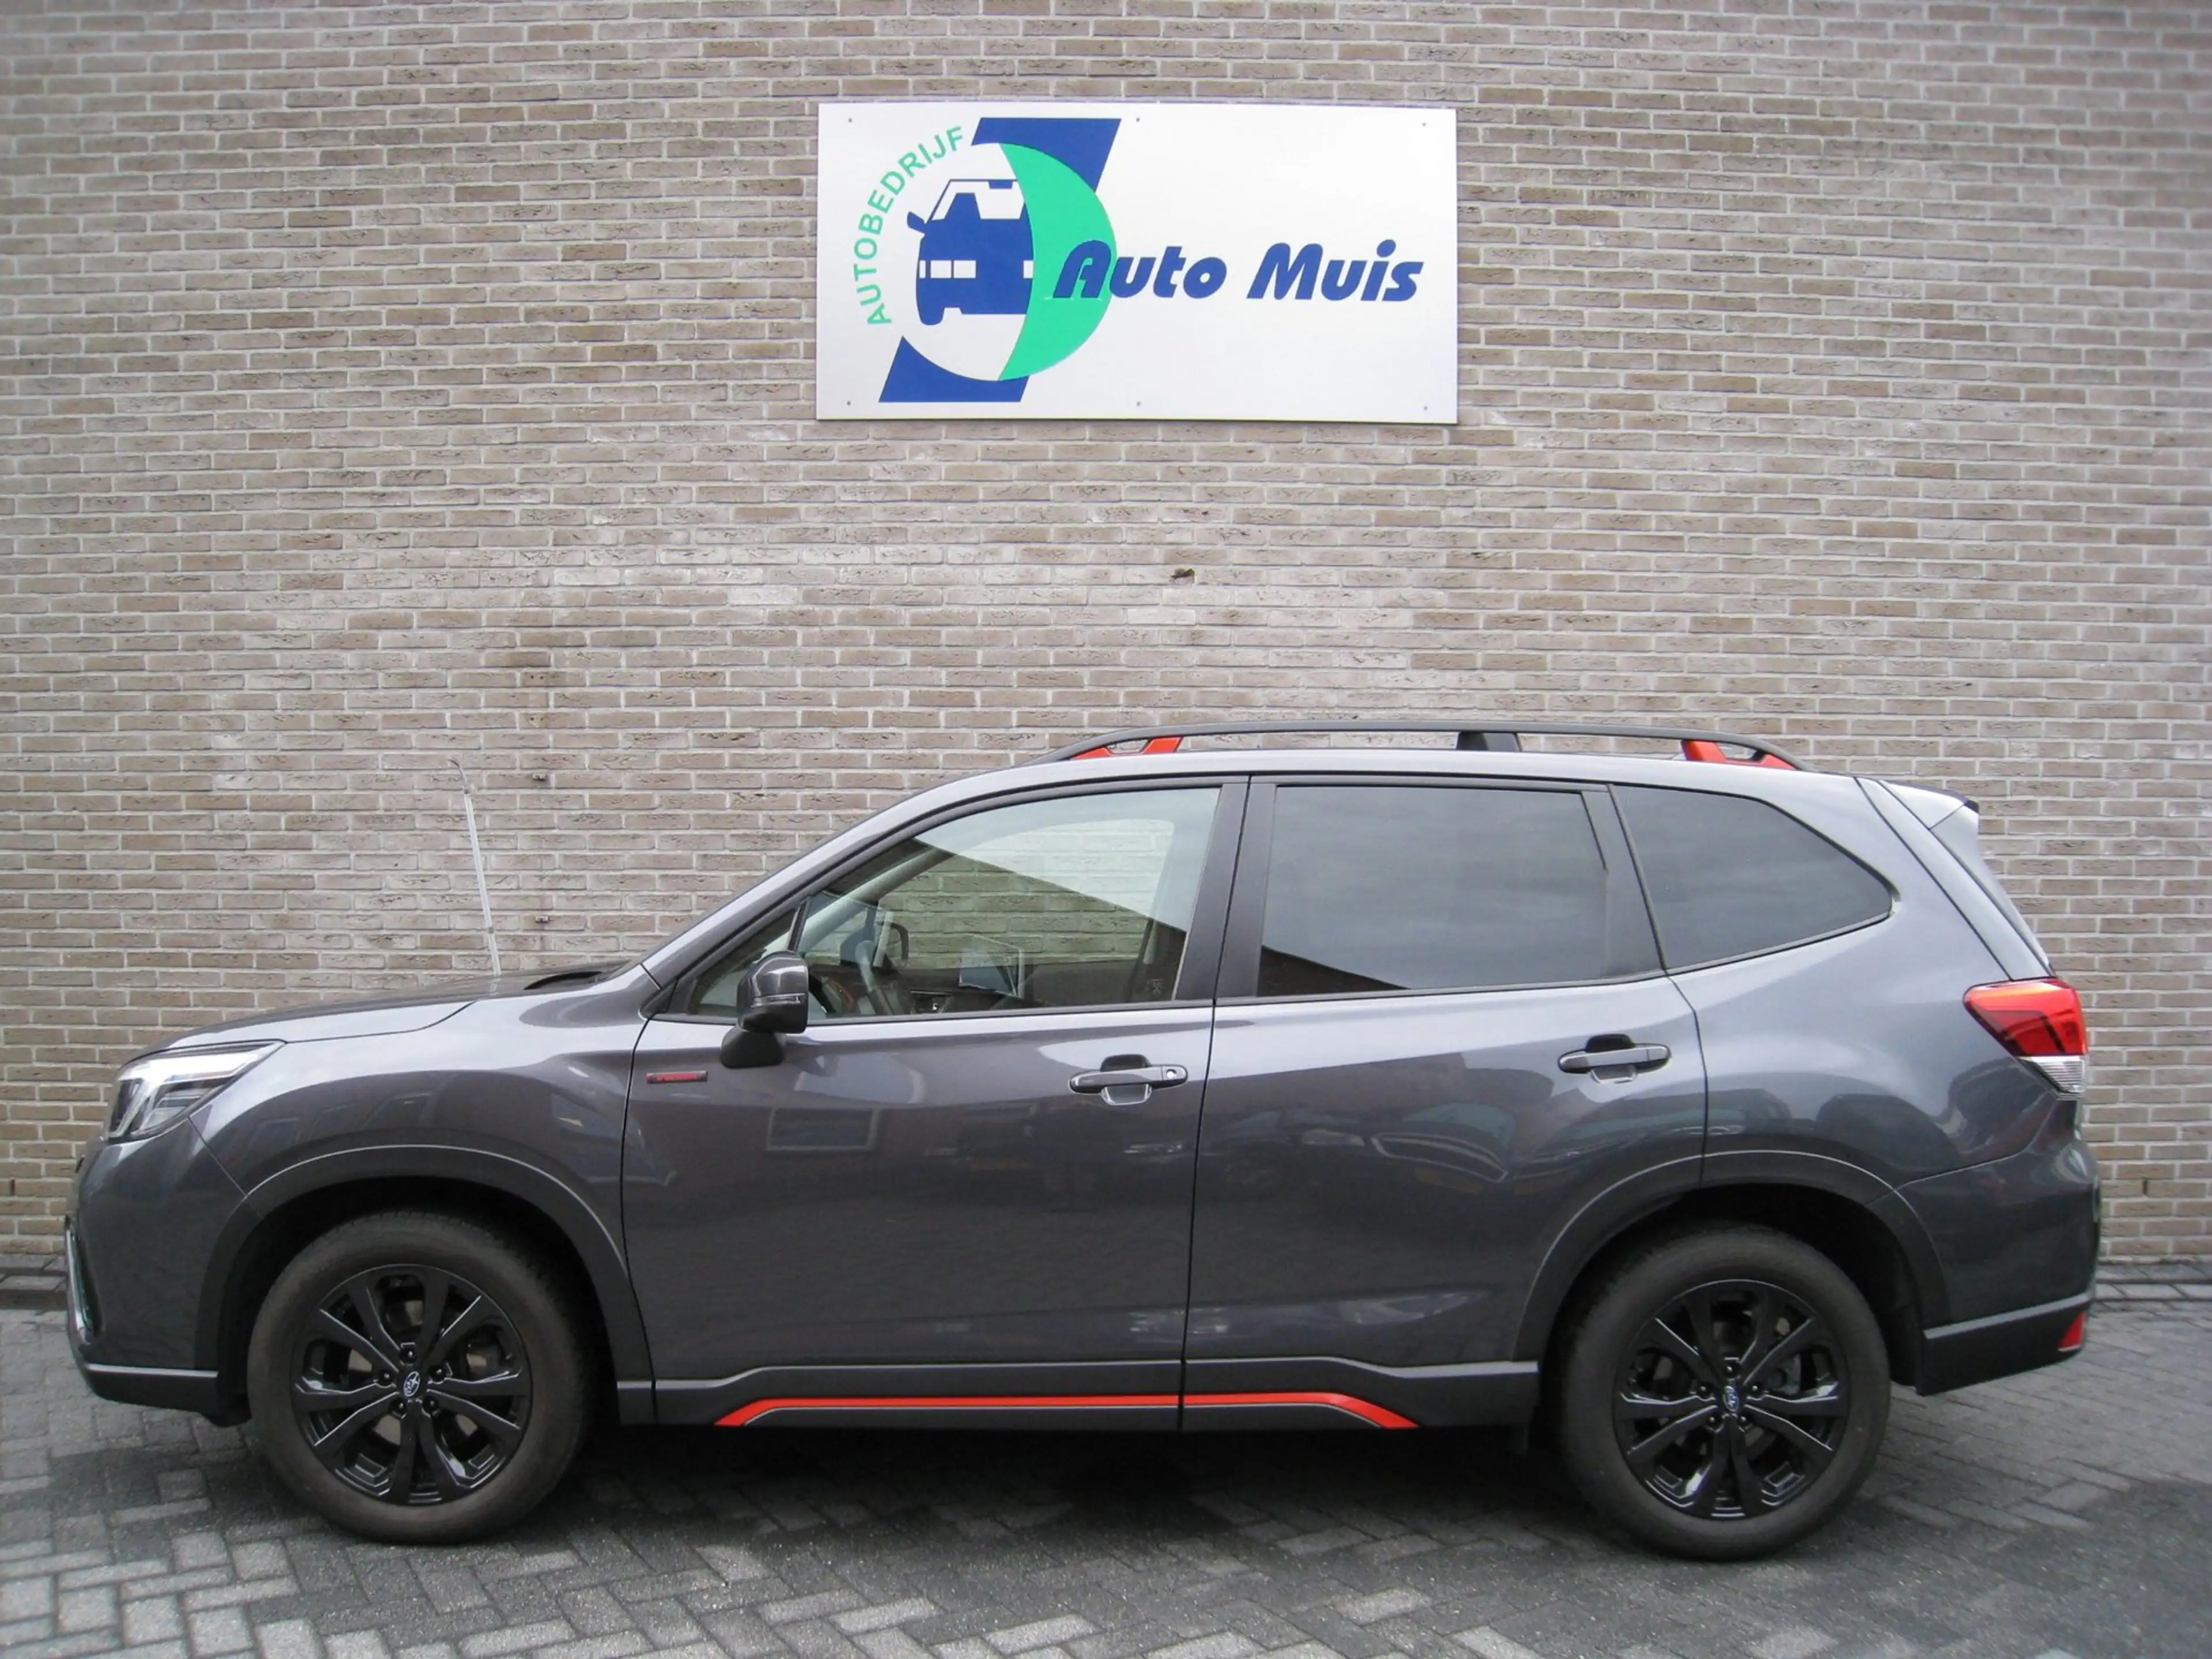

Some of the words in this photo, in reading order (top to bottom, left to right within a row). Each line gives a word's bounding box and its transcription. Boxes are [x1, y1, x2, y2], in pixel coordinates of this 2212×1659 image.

[853, 126, 964, 325] AUTOBEDRIJF
[1052, 239, 1228, 299] Auto
[1247, 239, 1424, 302] Muis
